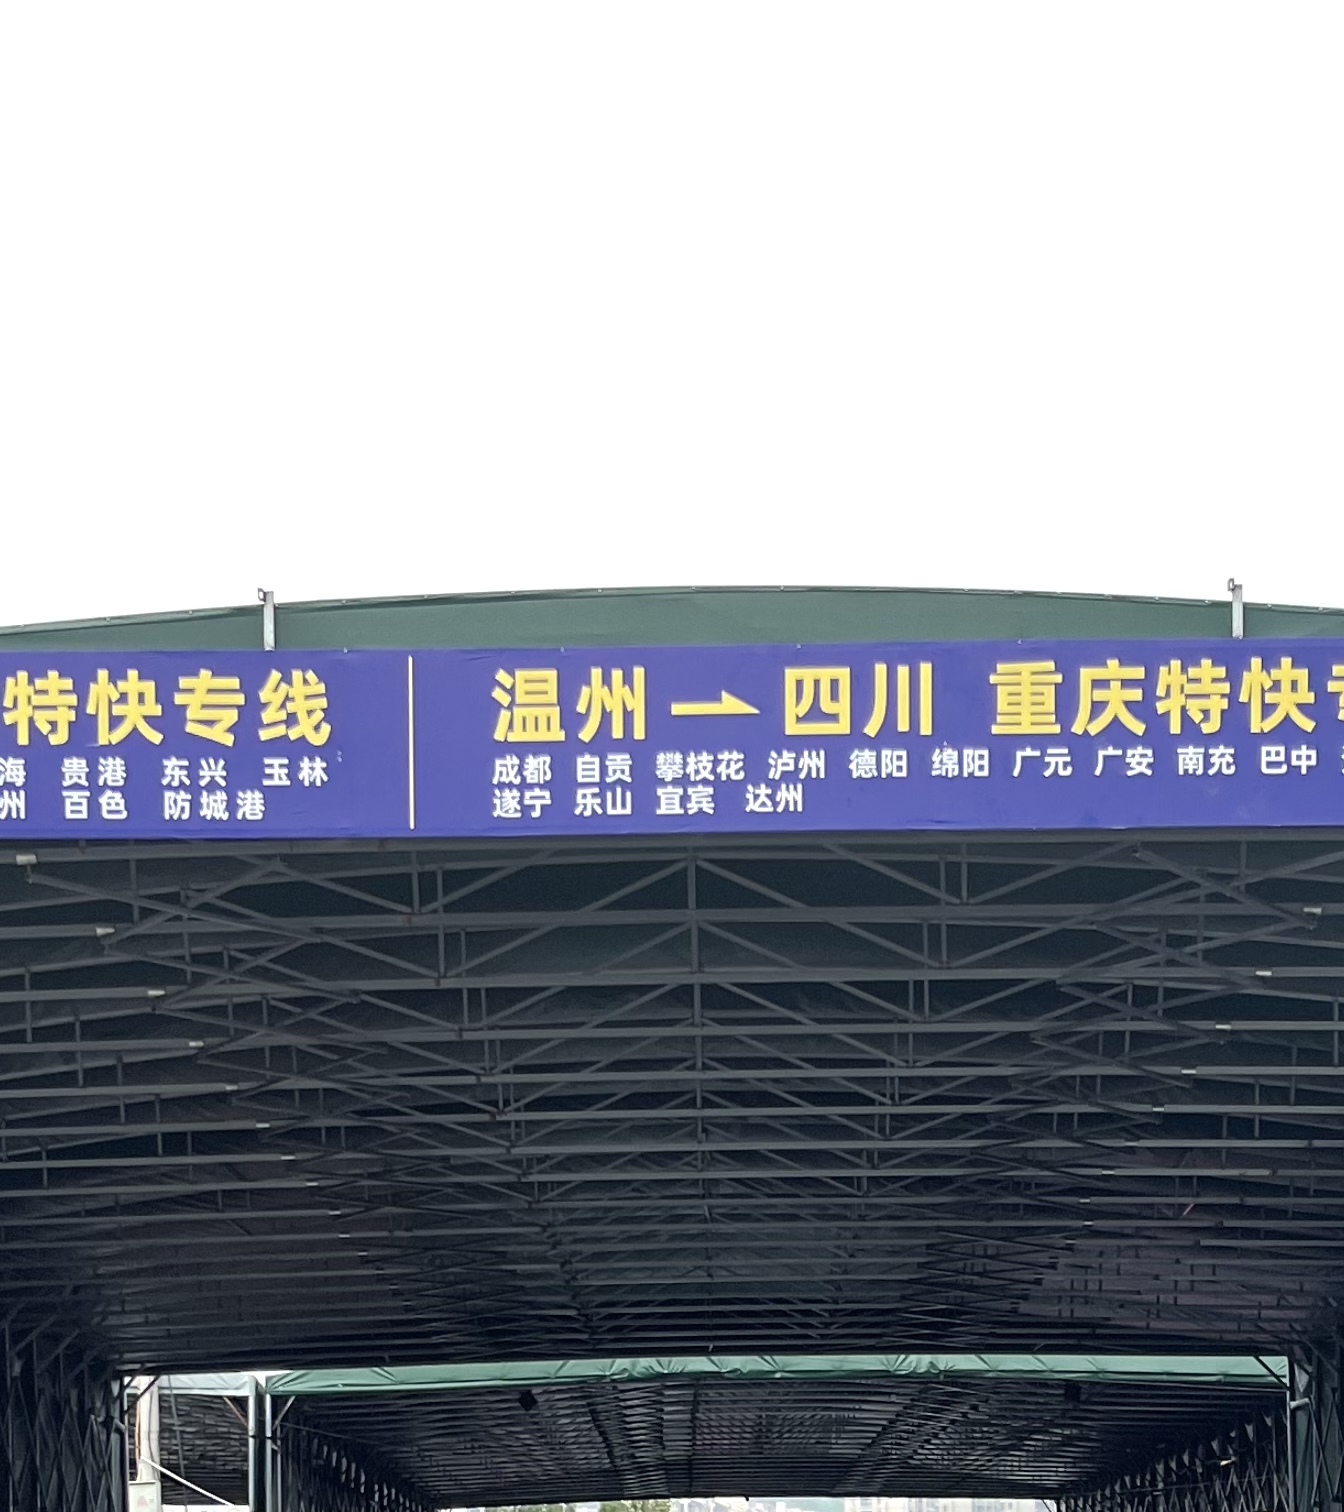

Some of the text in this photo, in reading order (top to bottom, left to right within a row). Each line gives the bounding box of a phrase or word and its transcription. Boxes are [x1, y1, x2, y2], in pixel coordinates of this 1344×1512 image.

[491, 666, 645, 743] 温州
[784, 661, 932, 737] 四川
[61, 756, 126, 787] 贵港
[161, 756, 226, 787] 东兴
[262, 756, 328, 786] 玉林
[492, 754, 551, 784] 成都
[577, 753, 632, 783] 自贡
[655, 750, 745, 782] 攀枝花
[768, 749, 825, 780] 泸州
[849, 748, 907, 778] 德阳
[932, 747, 989, 777] 绵阳
[1013, 747, 1072, 777] 广元
[1095, 745, 1153, 776] 广安
[1177, 745, 1235, 775] 南充
[1261, 745, 1316, 774] 巴中
[62, 789, 127, 819] 百色
[164, 790, 265, 820] 防城港
[492, 783, 802, 817] 遂宁 乐山 宜宾 达州
